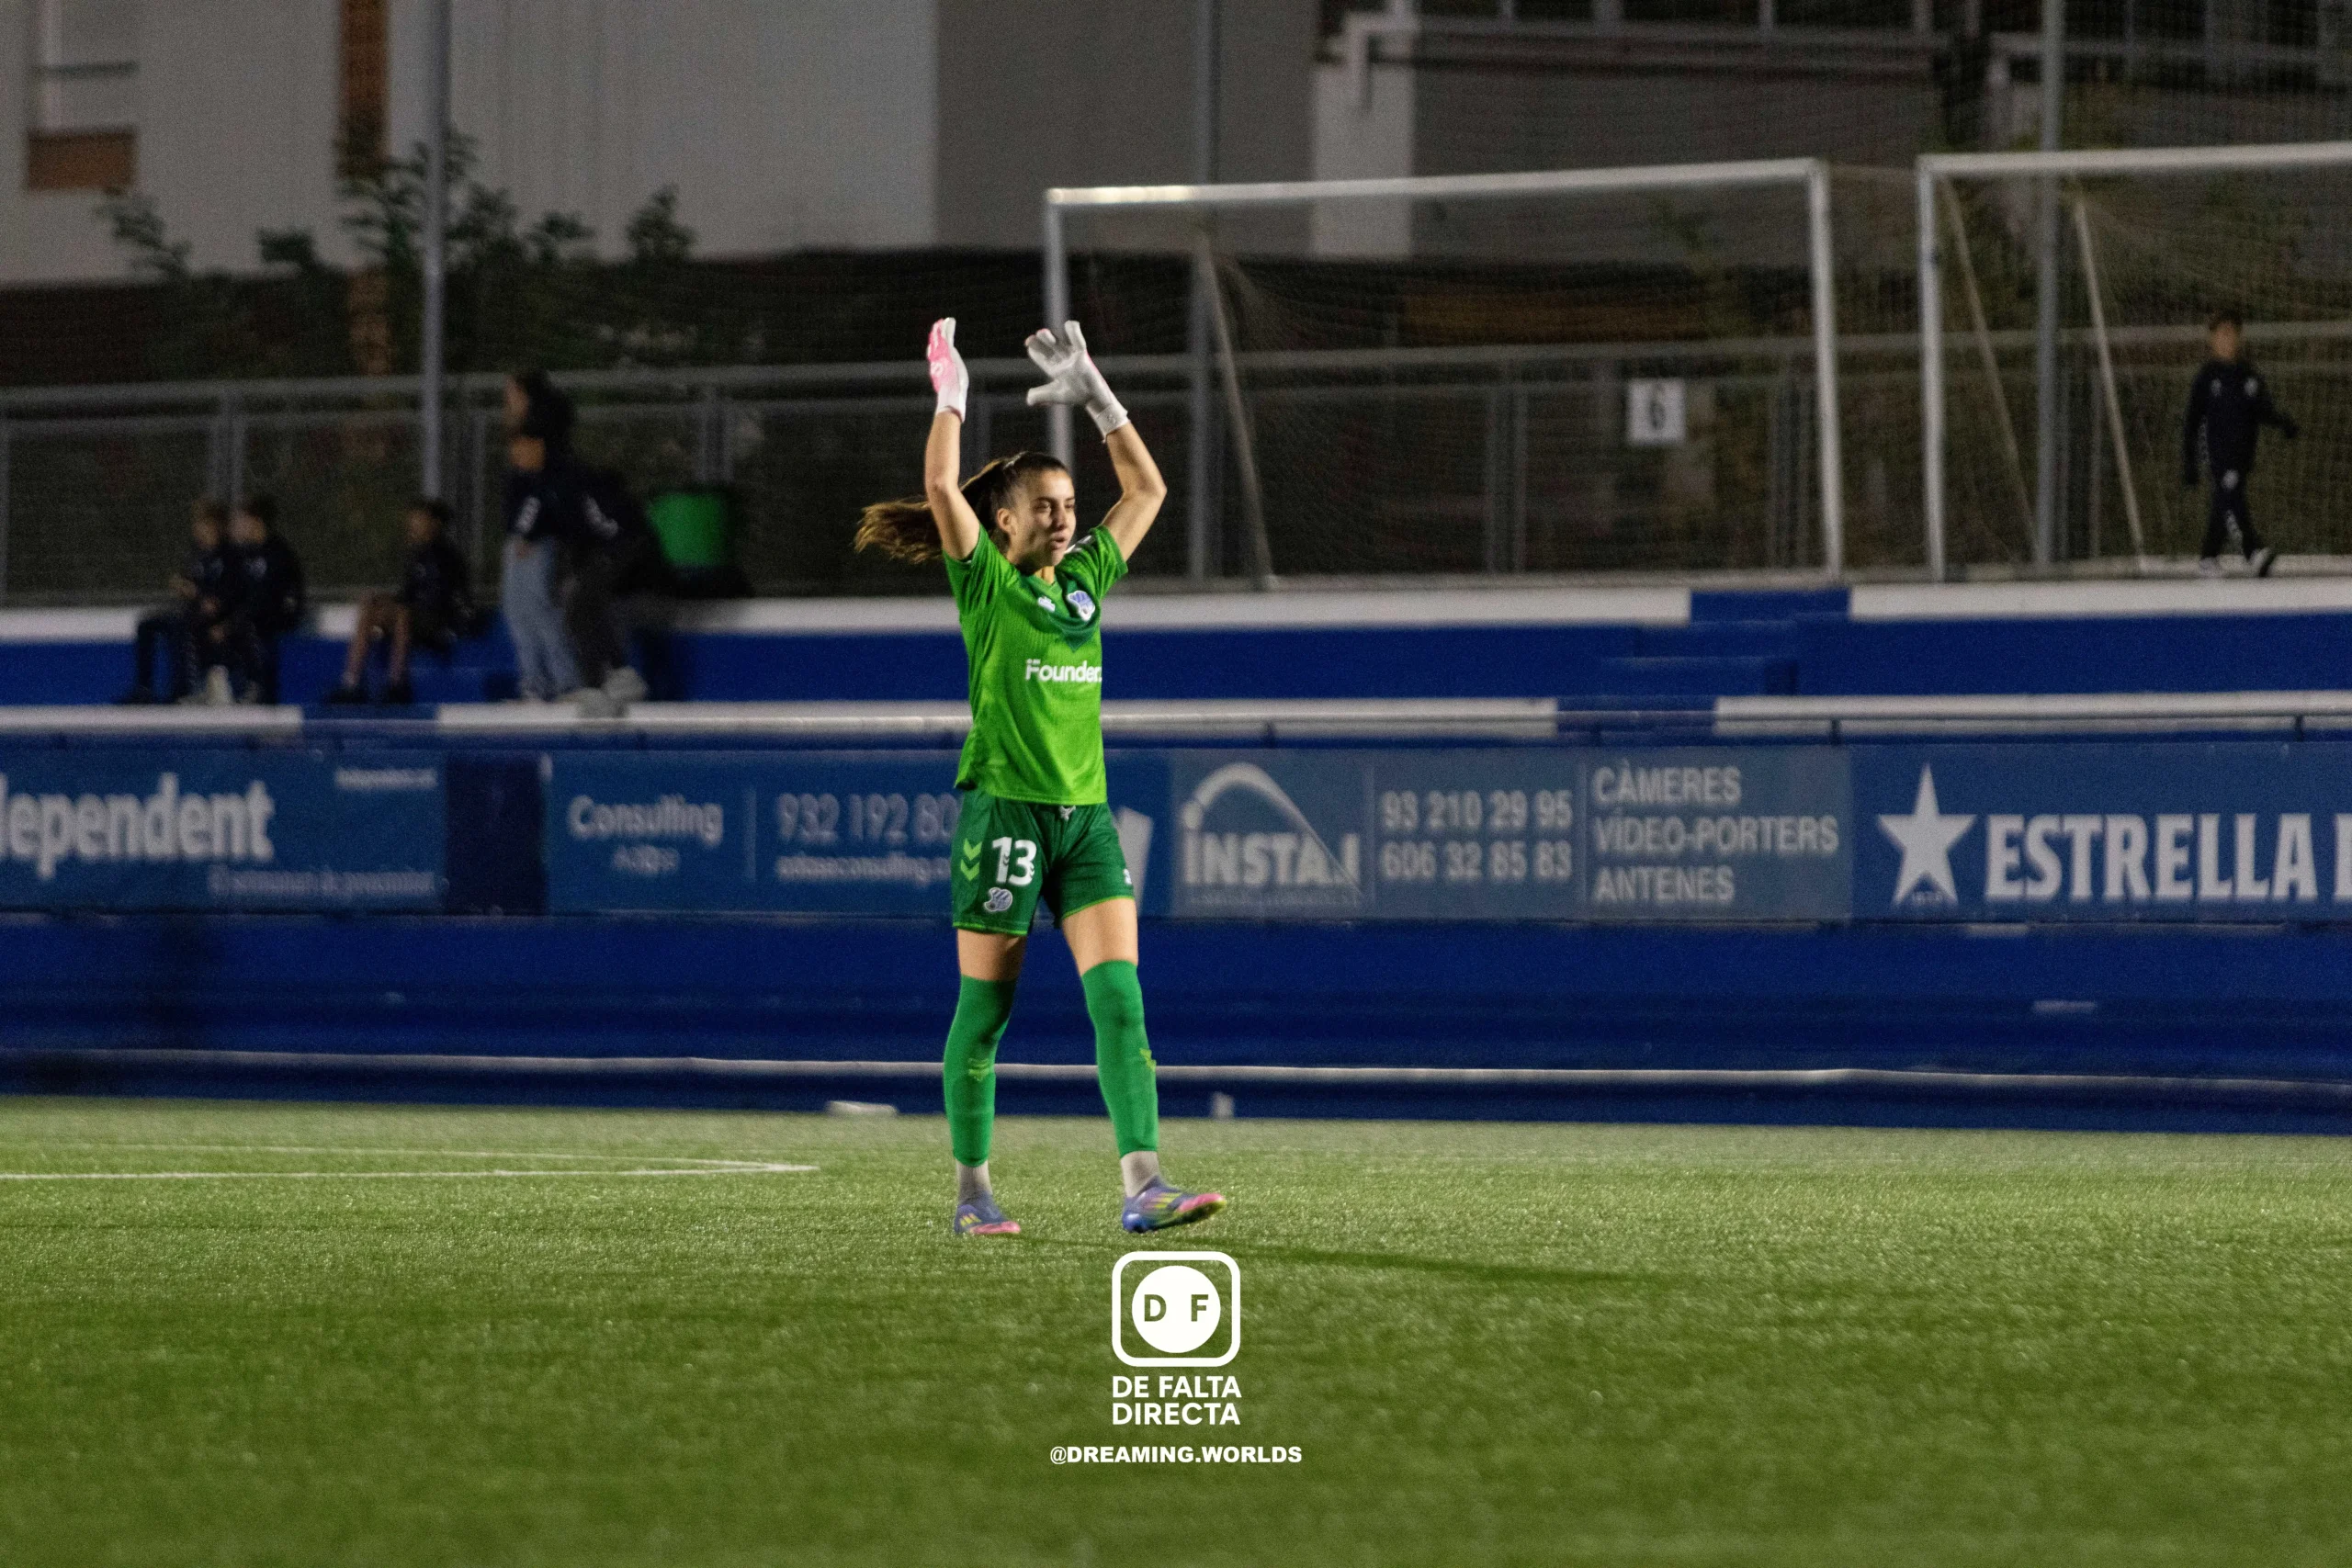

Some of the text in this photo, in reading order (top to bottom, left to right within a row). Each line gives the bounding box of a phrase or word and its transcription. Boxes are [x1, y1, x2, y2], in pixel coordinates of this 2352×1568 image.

[1592, 758, 1741, 805] CÀMERES
[0, 772, 274, 879] ependent
[849, 793, 908, 843] 192
[913, 793, 963, 843] 80
[1381, 789, 1573, 830] 93 210 29 95
[1593, 807, 1838, 853] VÍDEO-PORTERS
[991, 836, 1037, 886] 13
[1381, 840, 1436, 881] 606
[1445, 840, 1483, 881] 32
[1534, 840, 1572, 881] 83
[1984, 812, 2318, 901] ESTRELLA
[1593, 864, 1735, 904] ANTENES
